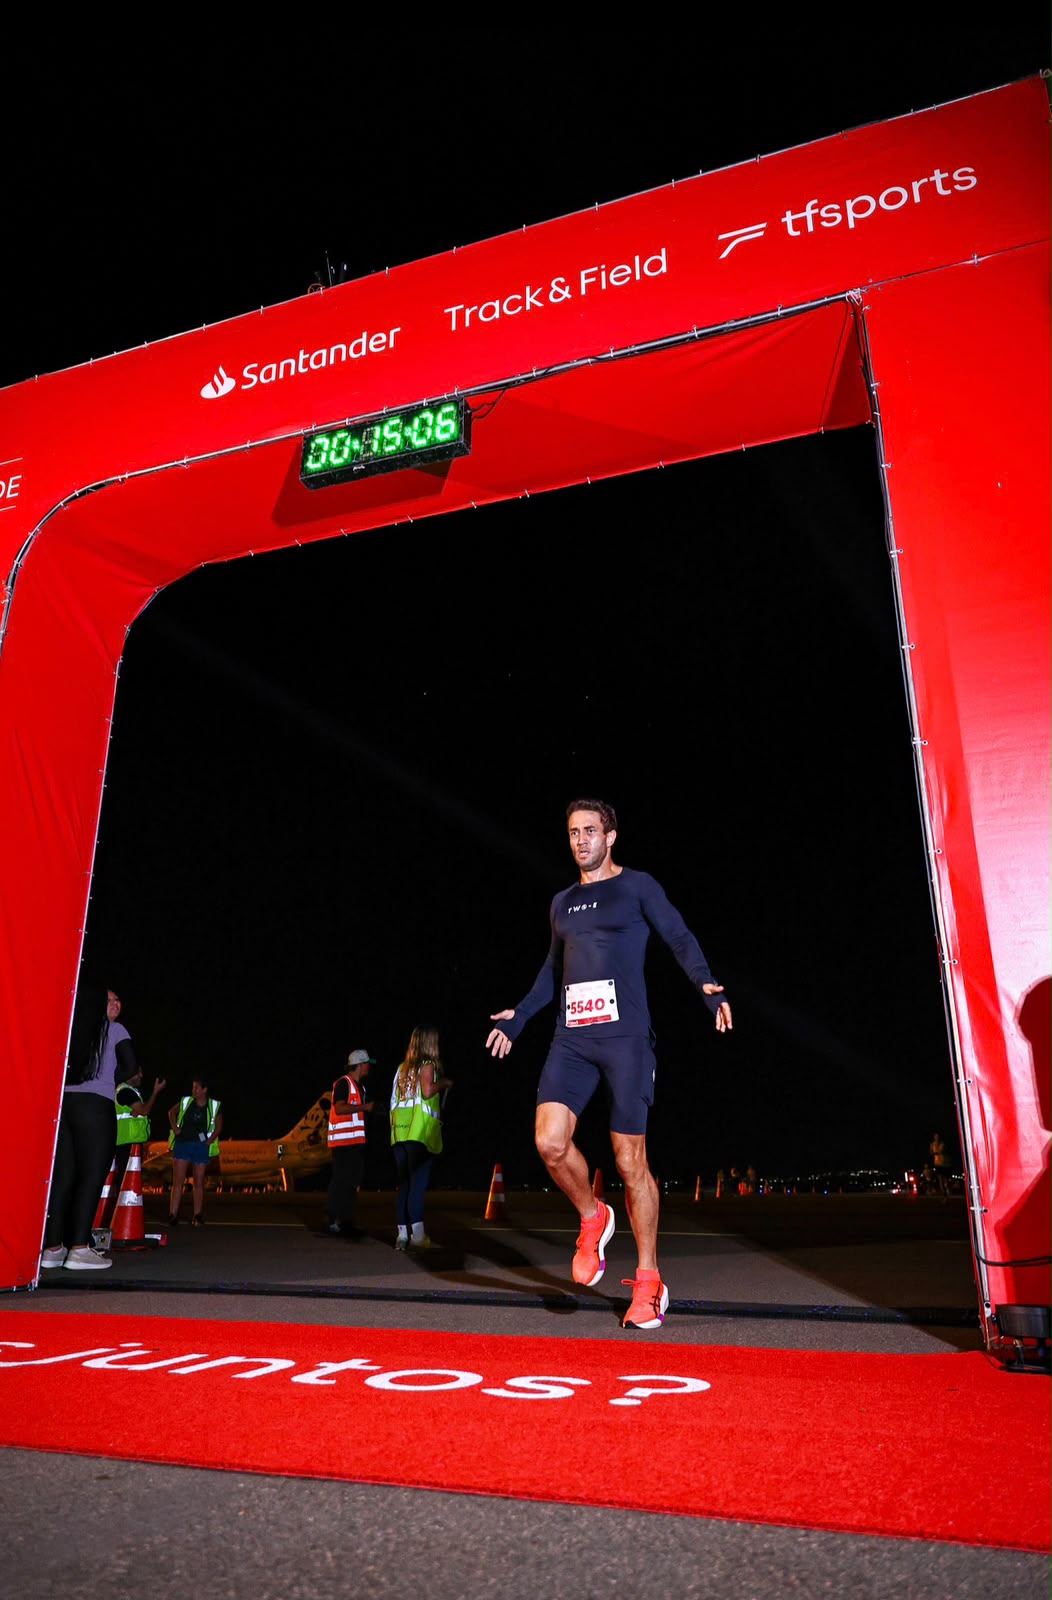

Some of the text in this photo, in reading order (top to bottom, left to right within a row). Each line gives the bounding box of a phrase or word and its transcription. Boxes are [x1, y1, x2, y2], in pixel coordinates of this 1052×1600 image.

[781, 166, 978, 237] tfsports
[443, 246, 668, 332] Track & Field
[241, 326, 402, 391] Santander
[305, 404, 457, 470] 00:15:06
[570, 997, 606, 1015] 5540
[0, 1343, 712, 1406] juntos?
